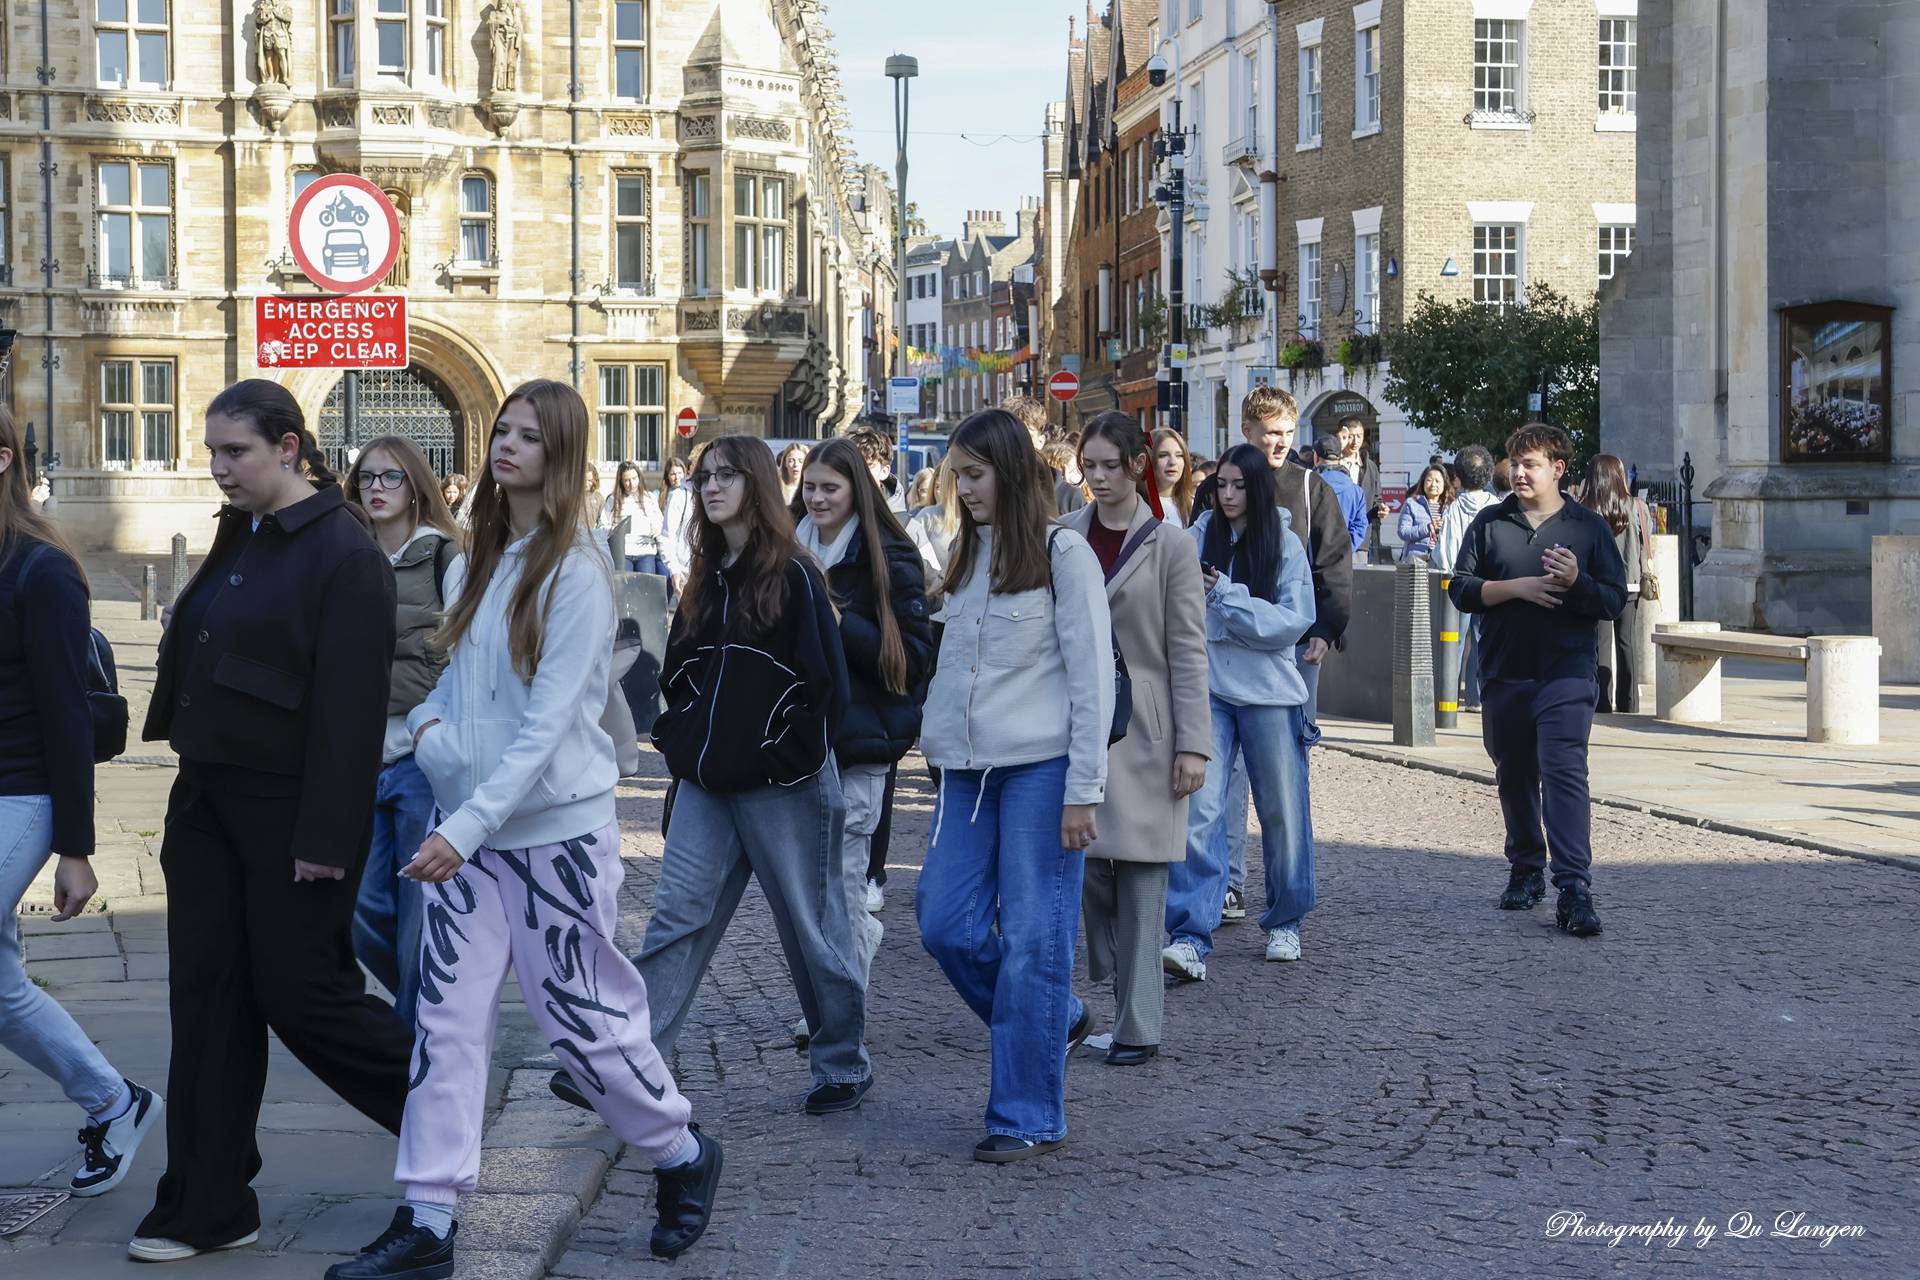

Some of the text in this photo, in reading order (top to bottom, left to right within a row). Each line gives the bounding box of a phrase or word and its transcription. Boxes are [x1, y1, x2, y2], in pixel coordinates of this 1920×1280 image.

[264, 301, 399, 319] EMERGENCY
[288, 322, 374, 339] ACCESS
[267, 342, 398, 360] EEP CLEAR
